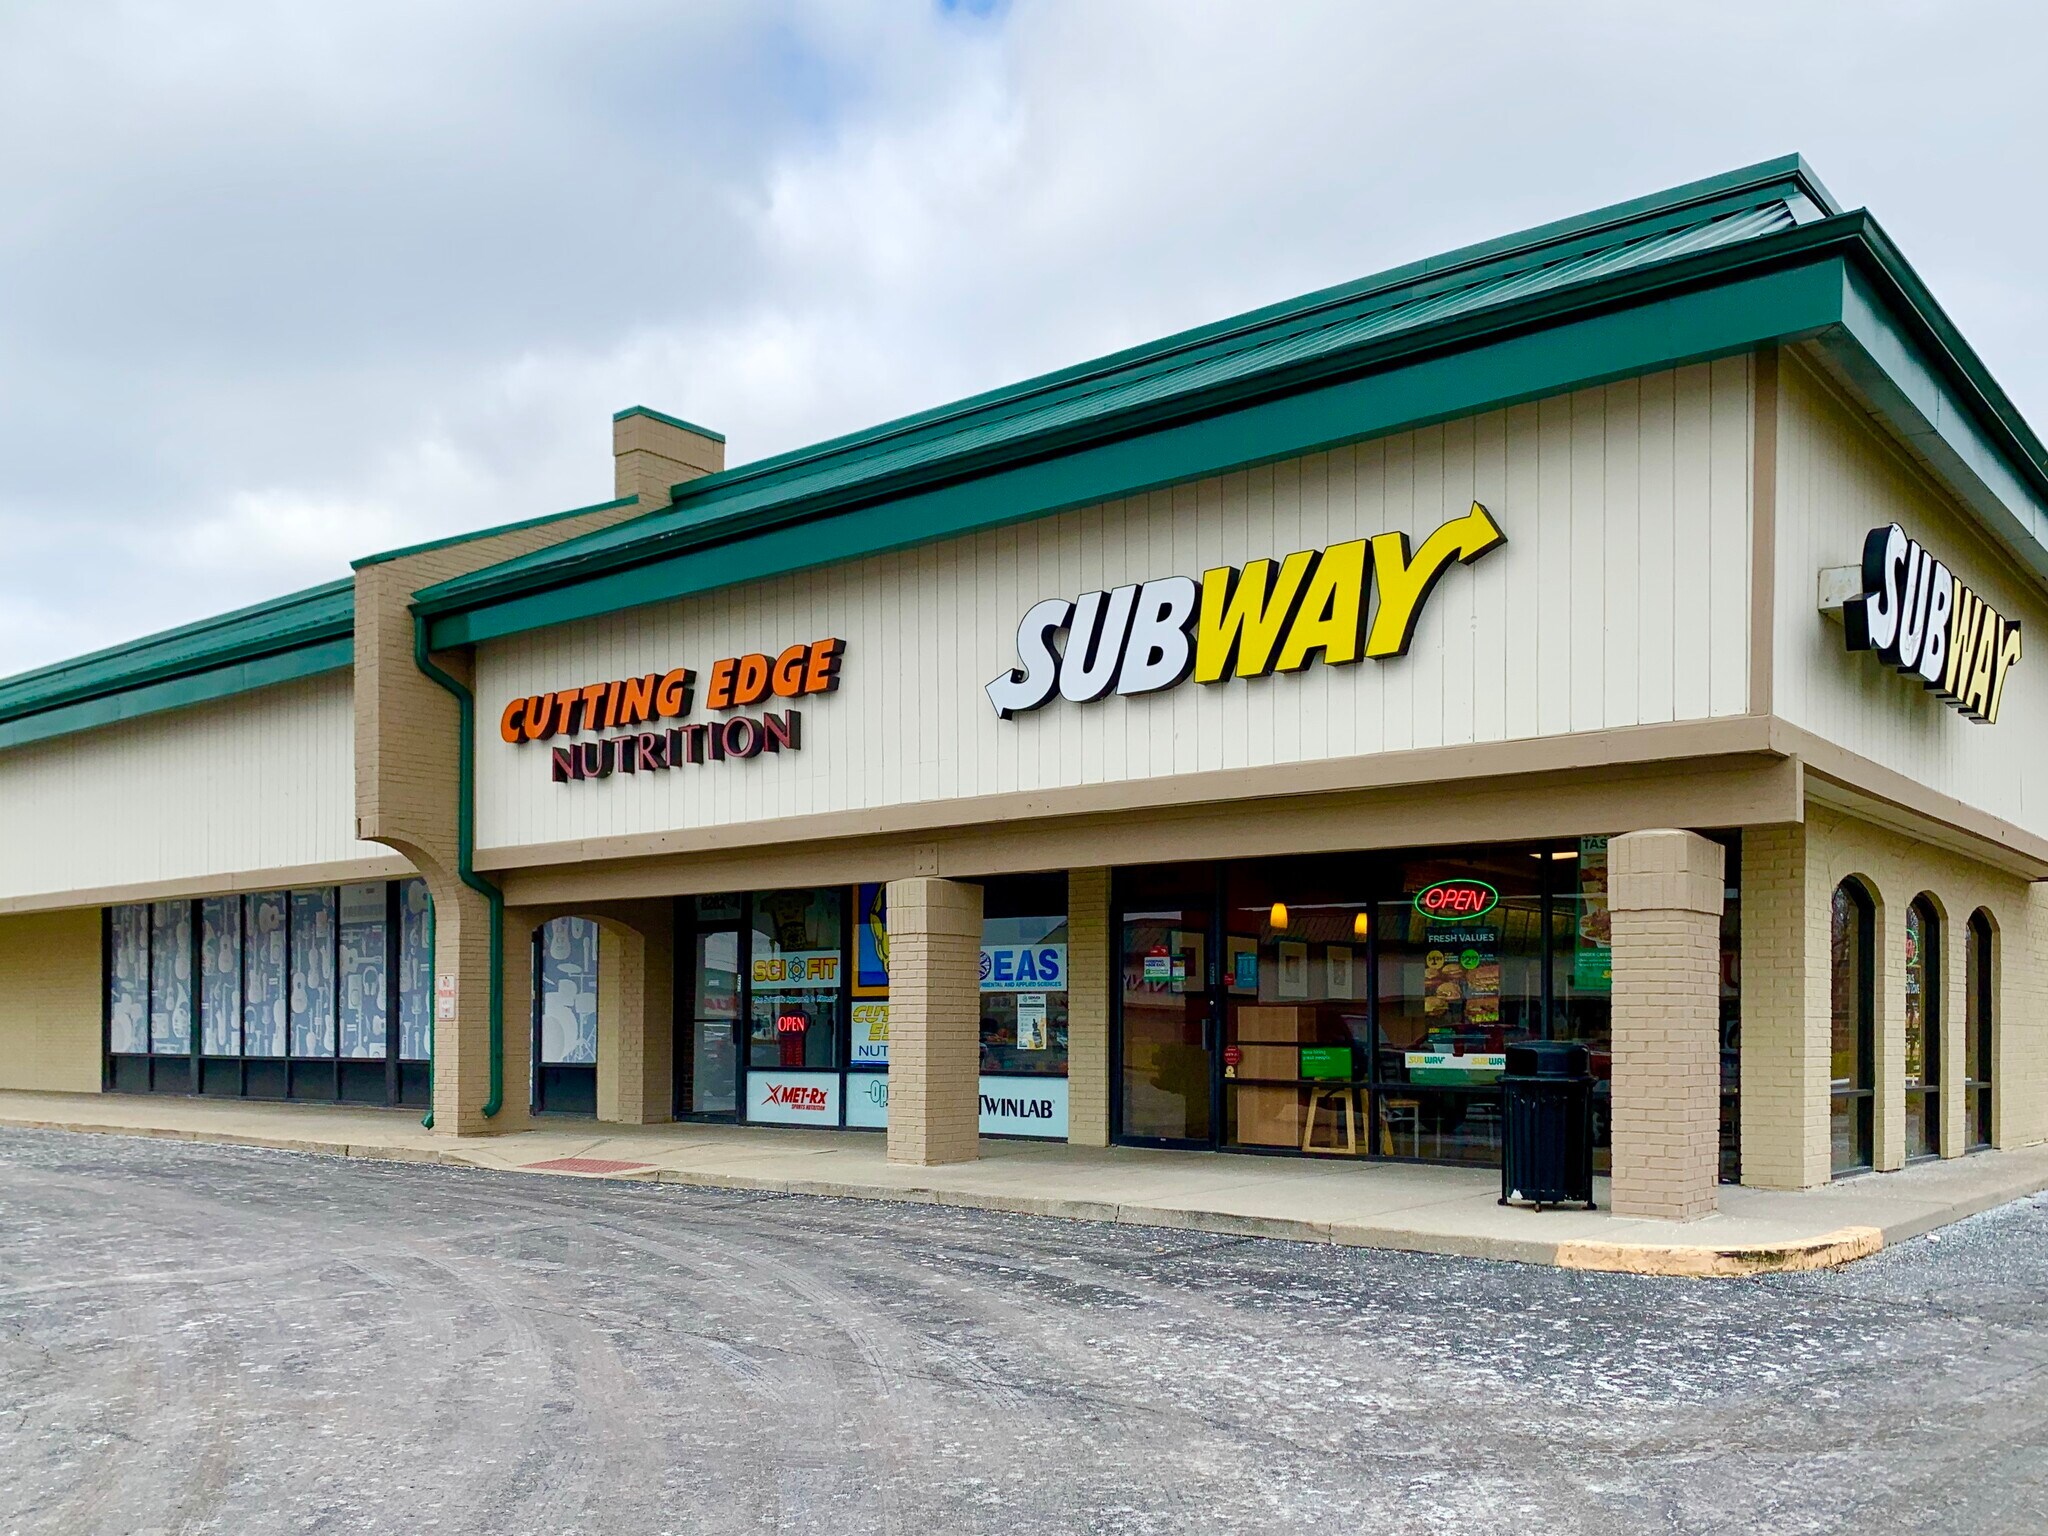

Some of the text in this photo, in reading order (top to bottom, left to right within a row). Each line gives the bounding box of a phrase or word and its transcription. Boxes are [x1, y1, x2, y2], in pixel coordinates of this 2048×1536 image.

[985, 501, 1507, 720] SUBWAY
[1846, 522, 2023, 724] SUBWAY
[501, 637, 847, 744] CUTTING EDGE
[552, 709, 802, 783] NUTRITION
[1426, 888, 1486, 911] OPEN
[1428, 933, 1495, 943] FRESH VALUES
[753, 957, 838, 982] SCI FIT
[993, 948, 1060, 981] EAS
[777, 1016, 805, 1033] OPEN
[1408, 1056, 1446, 1065] SUBWAY
[979, 1094, 1053, 1119] TWINLAB
